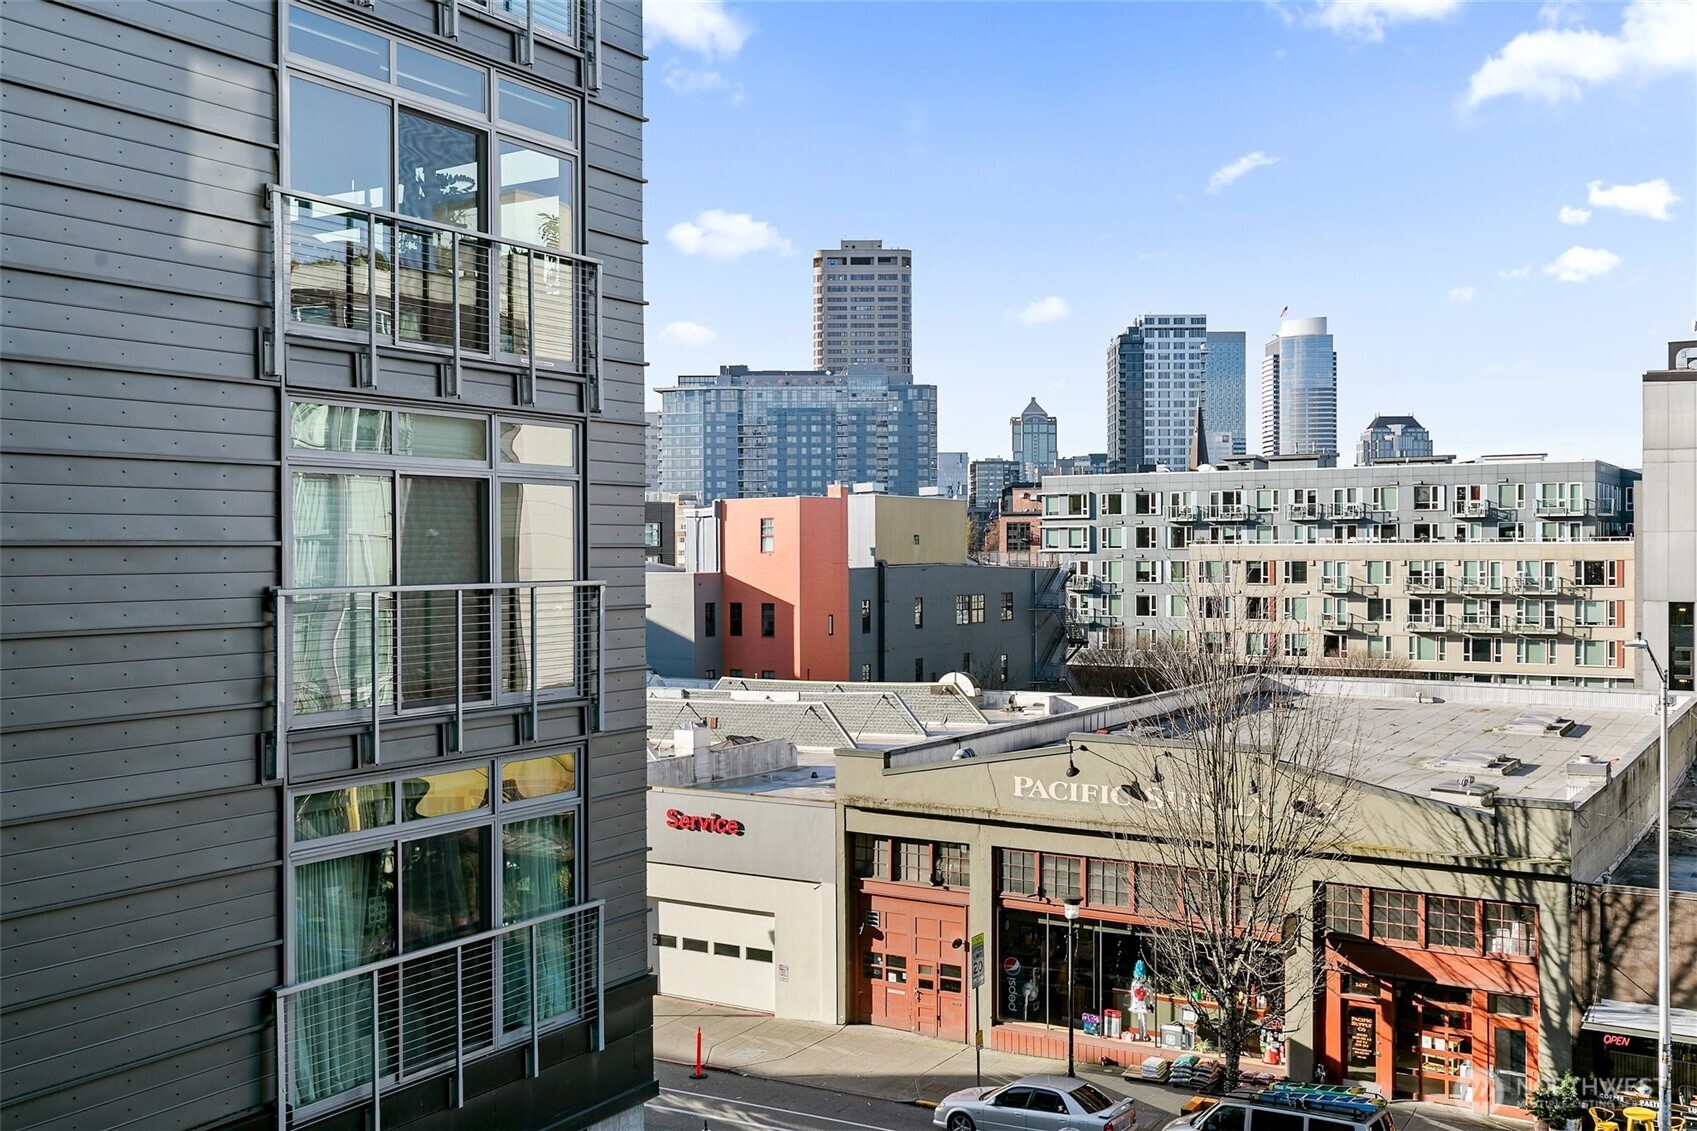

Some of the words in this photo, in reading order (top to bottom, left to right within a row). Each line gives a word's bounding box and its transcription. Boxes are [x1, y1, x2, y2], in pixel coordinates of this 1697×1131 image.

[1013, 776, 1132, 806] PACIFIC
[1144, 787, 1274, 816] SUPLY
[666, 808, 740, 835] Service
[973, 960, 983, 974] 20
[1007, 977, 1018, 1011] pepsi
[1603, 1034, 1630, 1047] OPEN
